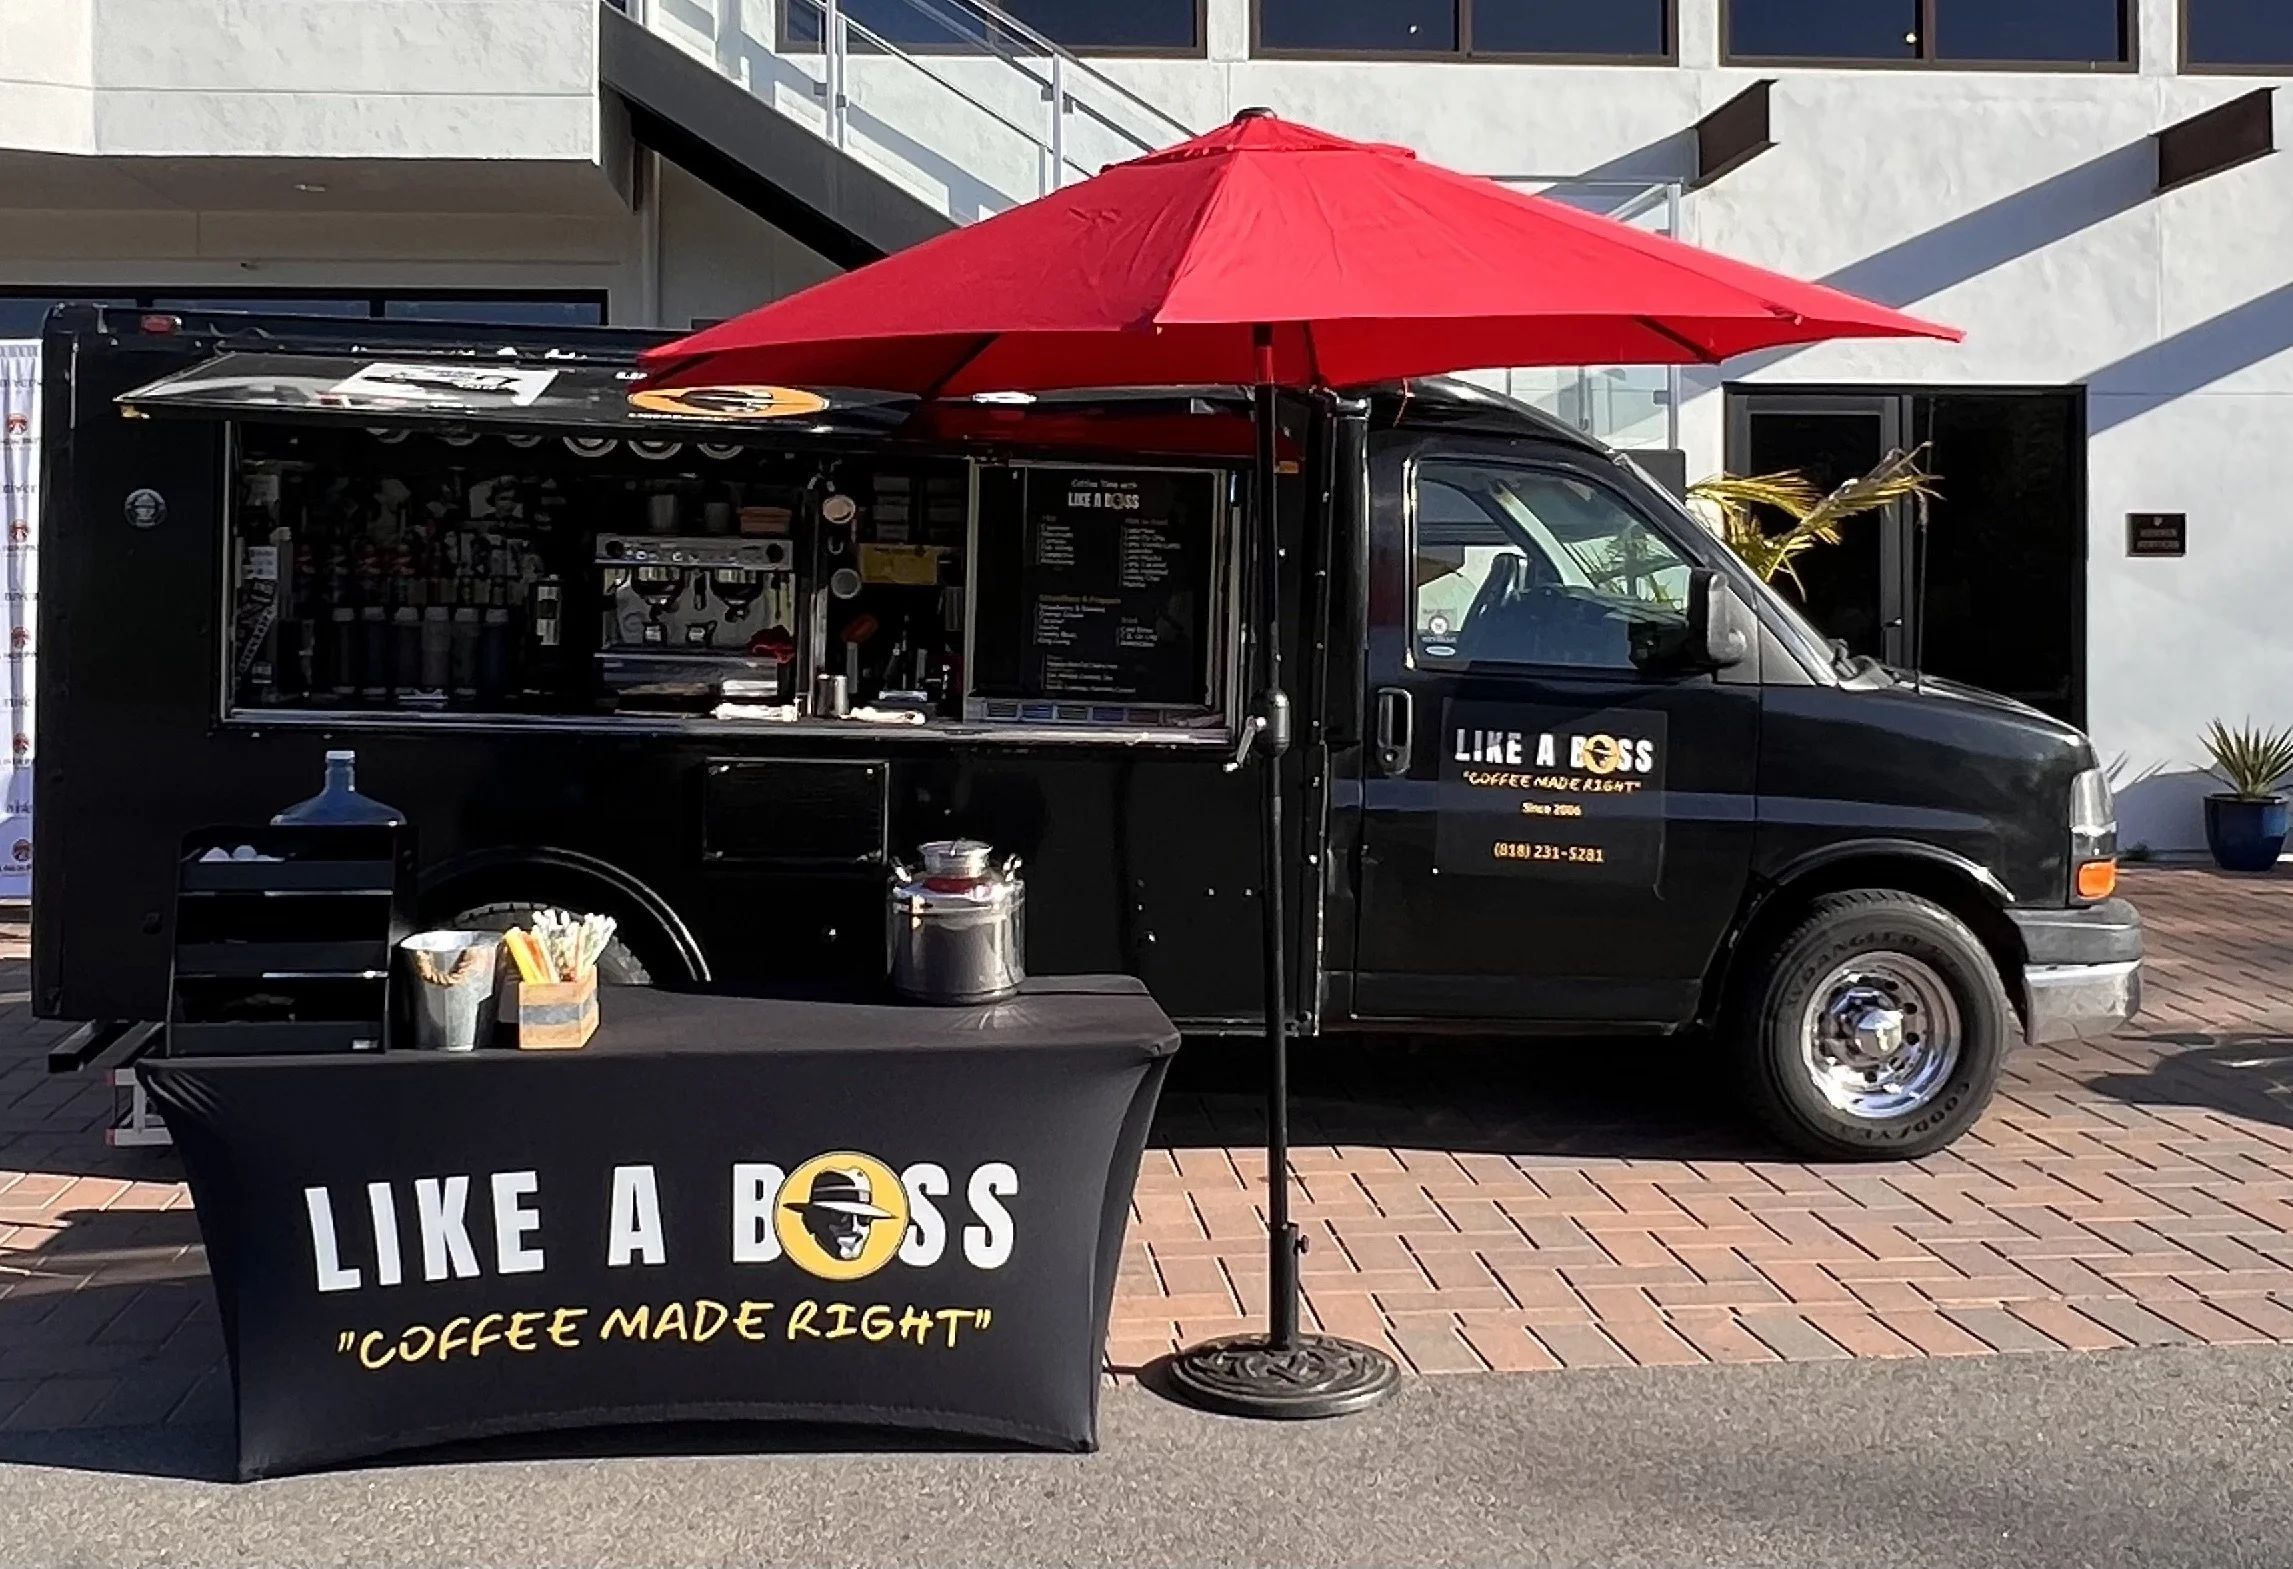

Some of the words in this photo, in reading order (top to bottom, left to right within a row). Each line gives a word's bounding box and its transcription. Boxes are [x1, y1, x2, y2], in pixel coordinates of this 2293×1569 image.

[1454, 728, 1523, 764] LIKE
[1535, 732, 1556, 767] A
[1570, 734, 1654, 774] BOSS
[1533, 775, 1582, 791] MADE
[1521, 802, 1552, 815] Since
[1493, 841, 1531, 858] (818)
[1533, 844, 1605, 863] 231-5281
[304, 1169, 546, 1293] LIKE
[606, 1164, 667, 1267] A
[731, 1150, 1020, 1280] BOSS
[335, 1306, 590, 1371] "COFFEE
[598, 1299, 776, 1346] MADE
[785, 1298, 993, 1349] RIGHT"
